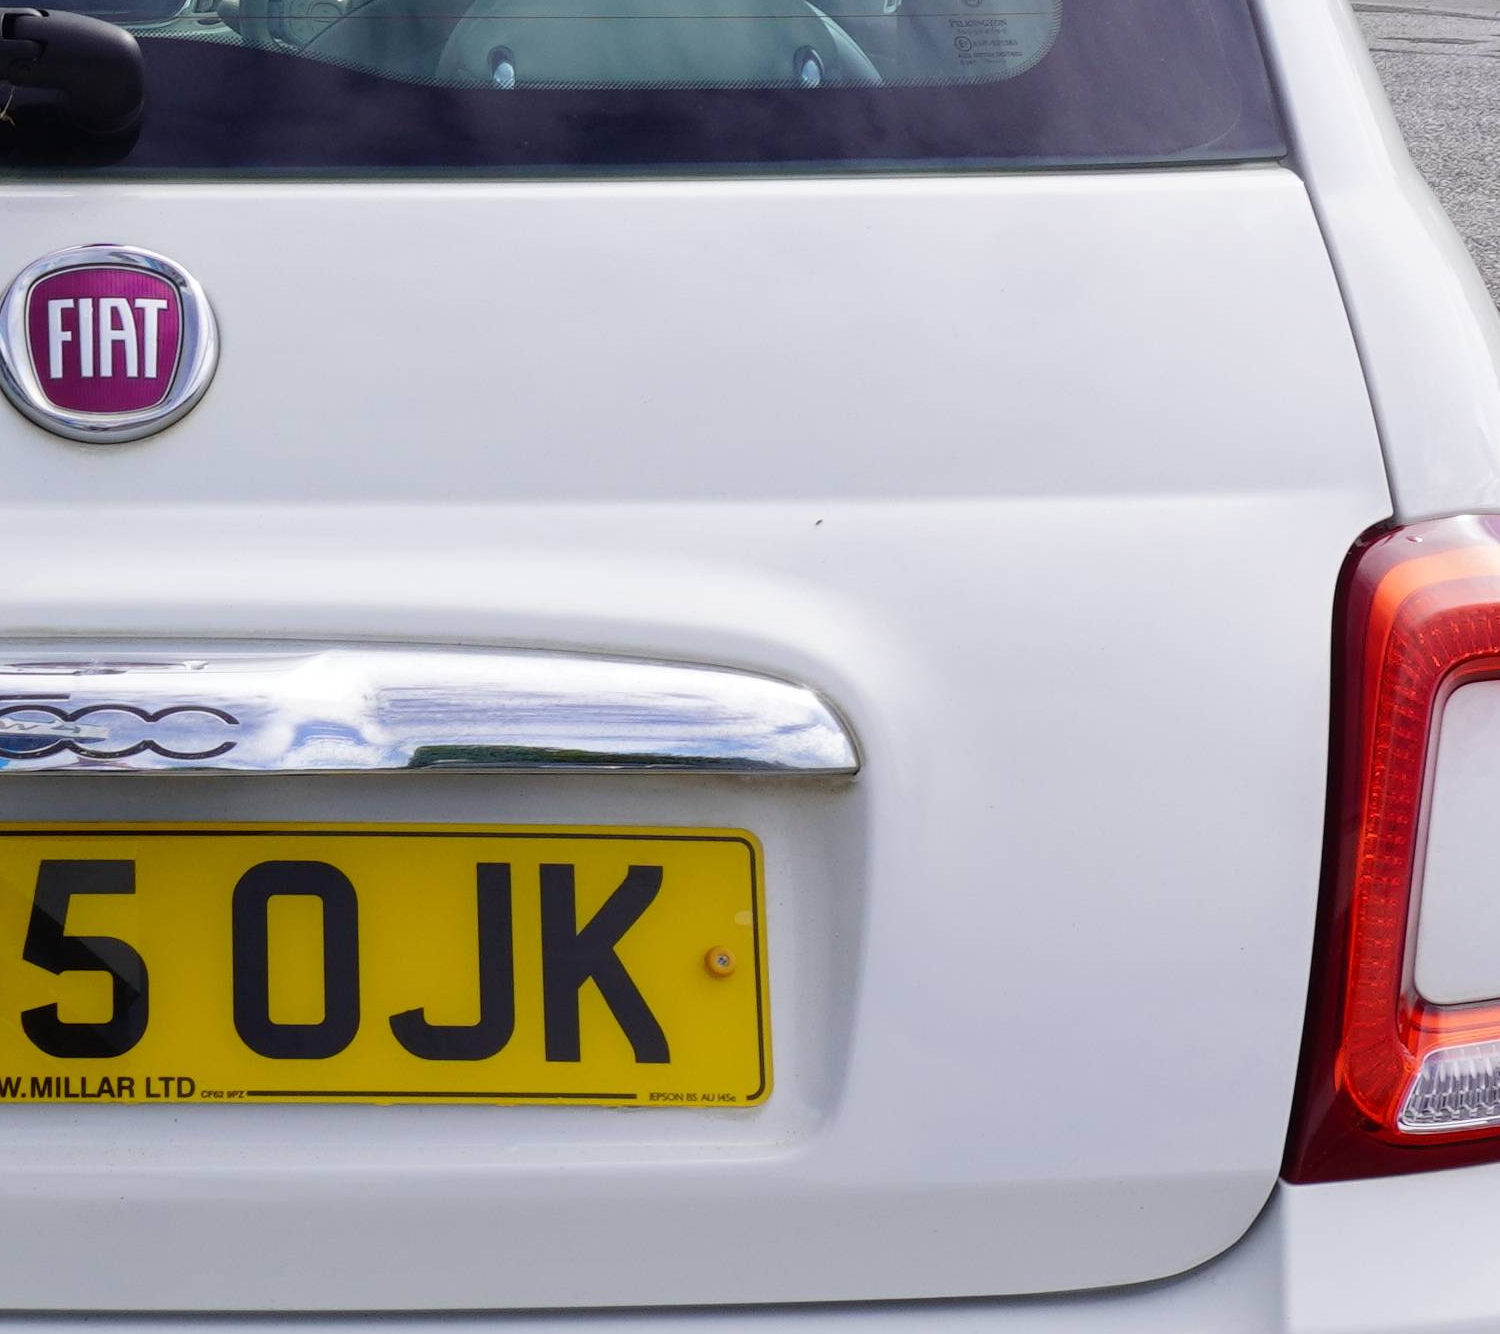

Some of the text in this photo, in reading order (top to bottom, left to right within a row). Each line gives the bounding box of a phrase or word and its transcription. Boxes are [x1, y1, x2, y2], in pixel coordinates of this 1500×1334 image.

[47, 297, 168, 379] FIAT
[229, 858, 673, 1065] OJK
[145, 1076, 196, 1098] LTD
[701, 1092, 713, 1102] AU
